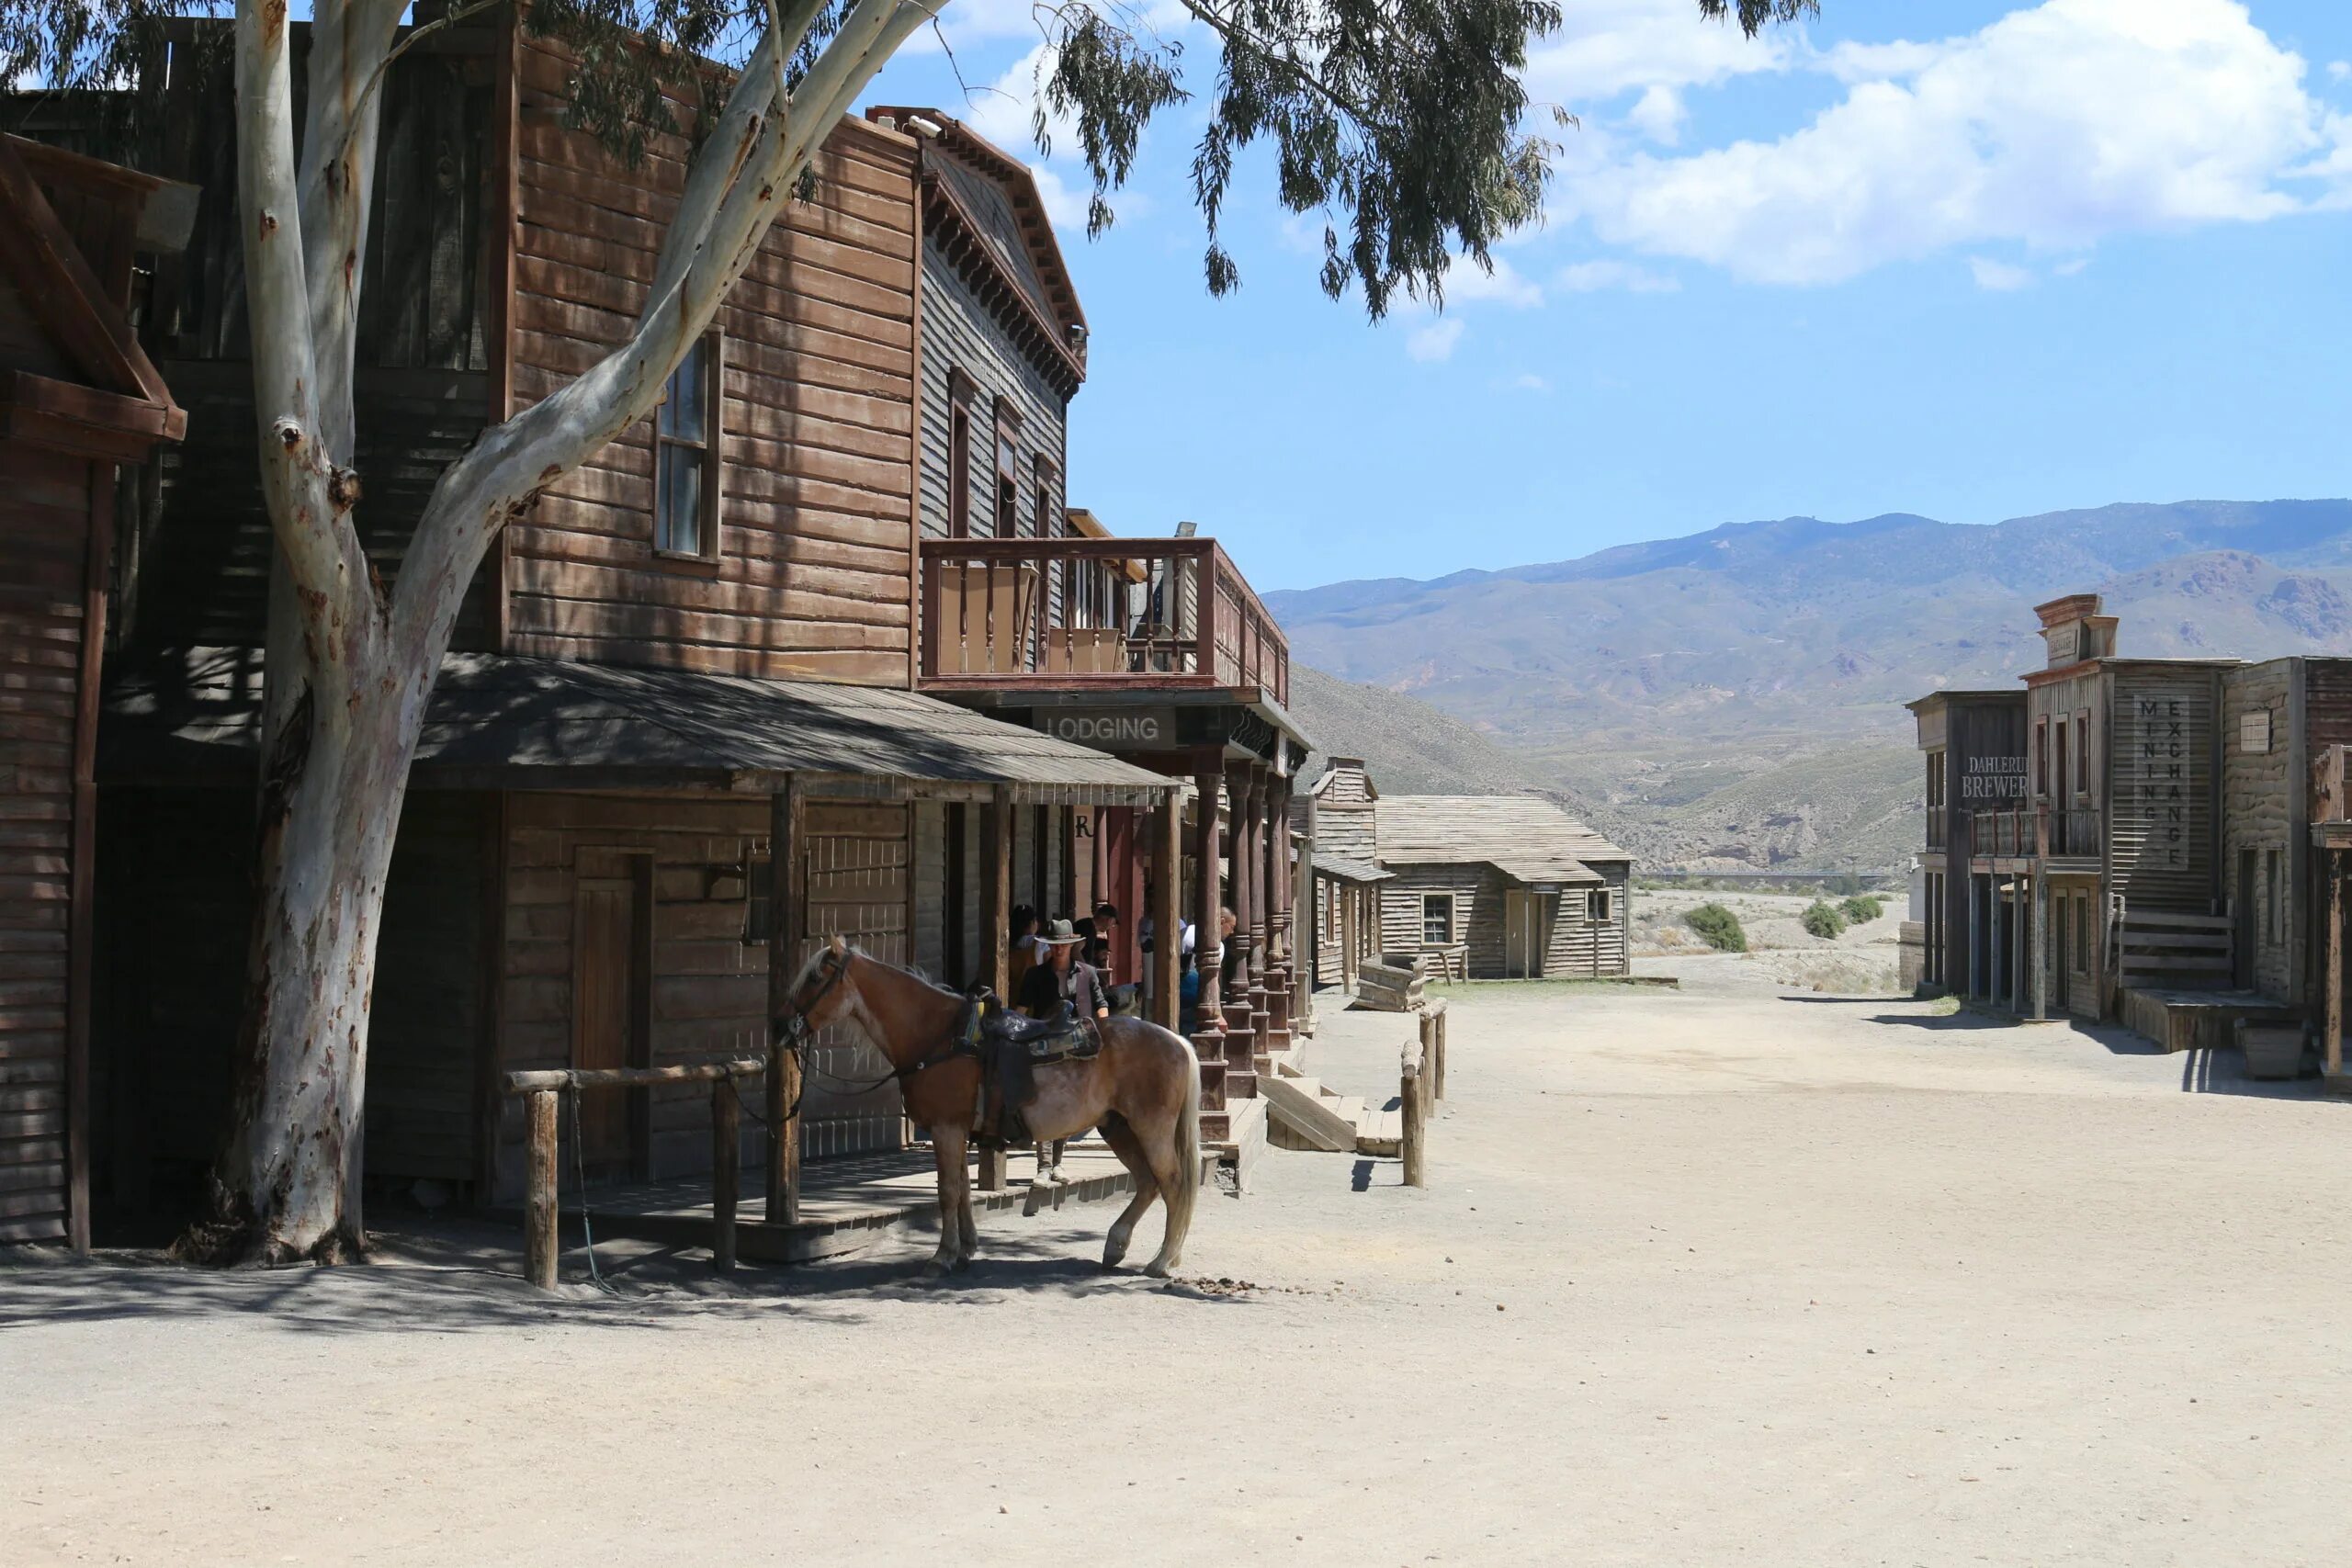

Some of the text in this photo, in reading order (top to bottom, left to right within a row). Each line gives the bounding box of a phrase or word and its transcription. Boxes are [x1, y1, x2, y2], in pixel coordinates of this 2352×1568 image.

[1046, 717, 1159, 739] LODGING
[2141, 701, 2156, 819] MINING
[2168, 701, 2182, 864] EXCHANGE
